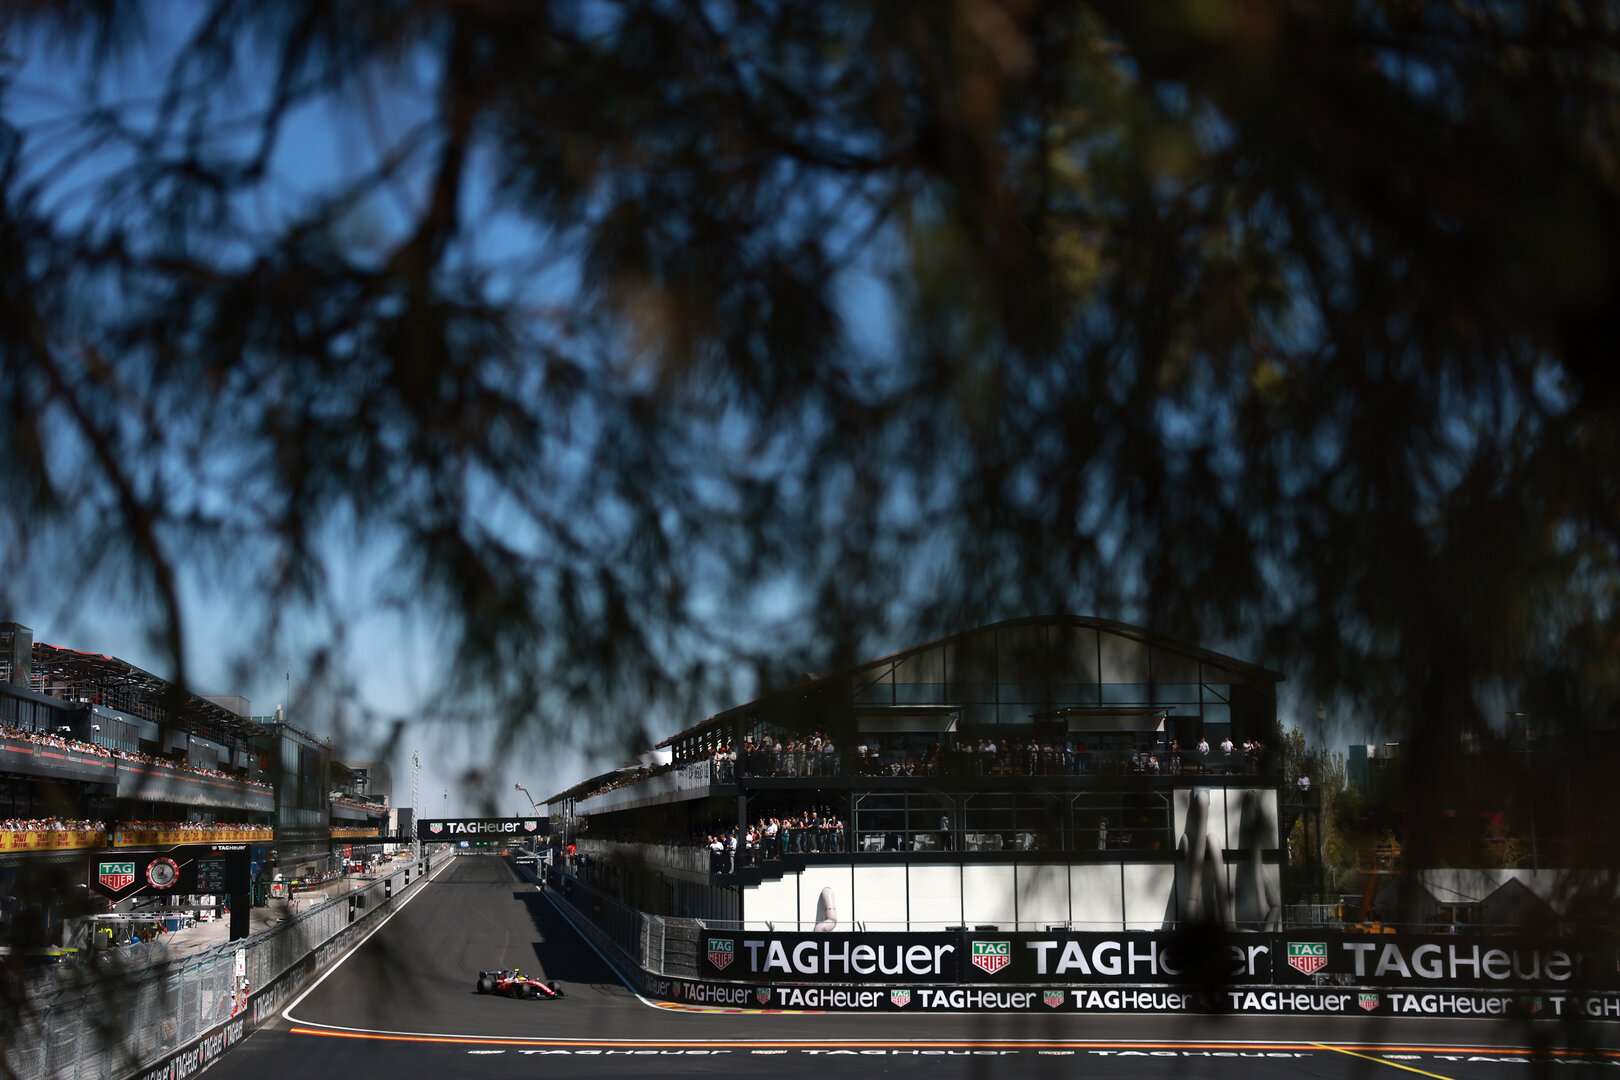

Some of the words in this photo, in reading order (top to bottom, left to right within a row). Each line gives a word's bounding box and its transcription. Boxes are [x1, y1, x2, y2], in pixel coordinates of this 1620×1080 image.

[446, 822, 520, 834] TAGHeuer
[102, 864, 132, 873] TAG
[101, 875, 132, 889] HEUER
[711, 941, 732, 951] TAG
[976, 944, 1007, 953] TAG
[1292, 944, 1324, 954] TAG
[710, 952, 732, 968] HEUER
[744, 940, 955, 974] TAGHeuer
[974, 955, 1008, 971] HEUER
[1290, 956, 1325, 973] HEUER
[683, 983, 752, 1003] TAGHeuer
[776, 988, 884, 1007] TAGHeuer
[917, 990, 1036, 1008] TAGHeuer
[1071, 990, 1192, 1009] TAGHeuer
[1228, 992, 1351, 1011] TAGHeuer
[1387, 994, 1512, 1014] TAGHeuer
